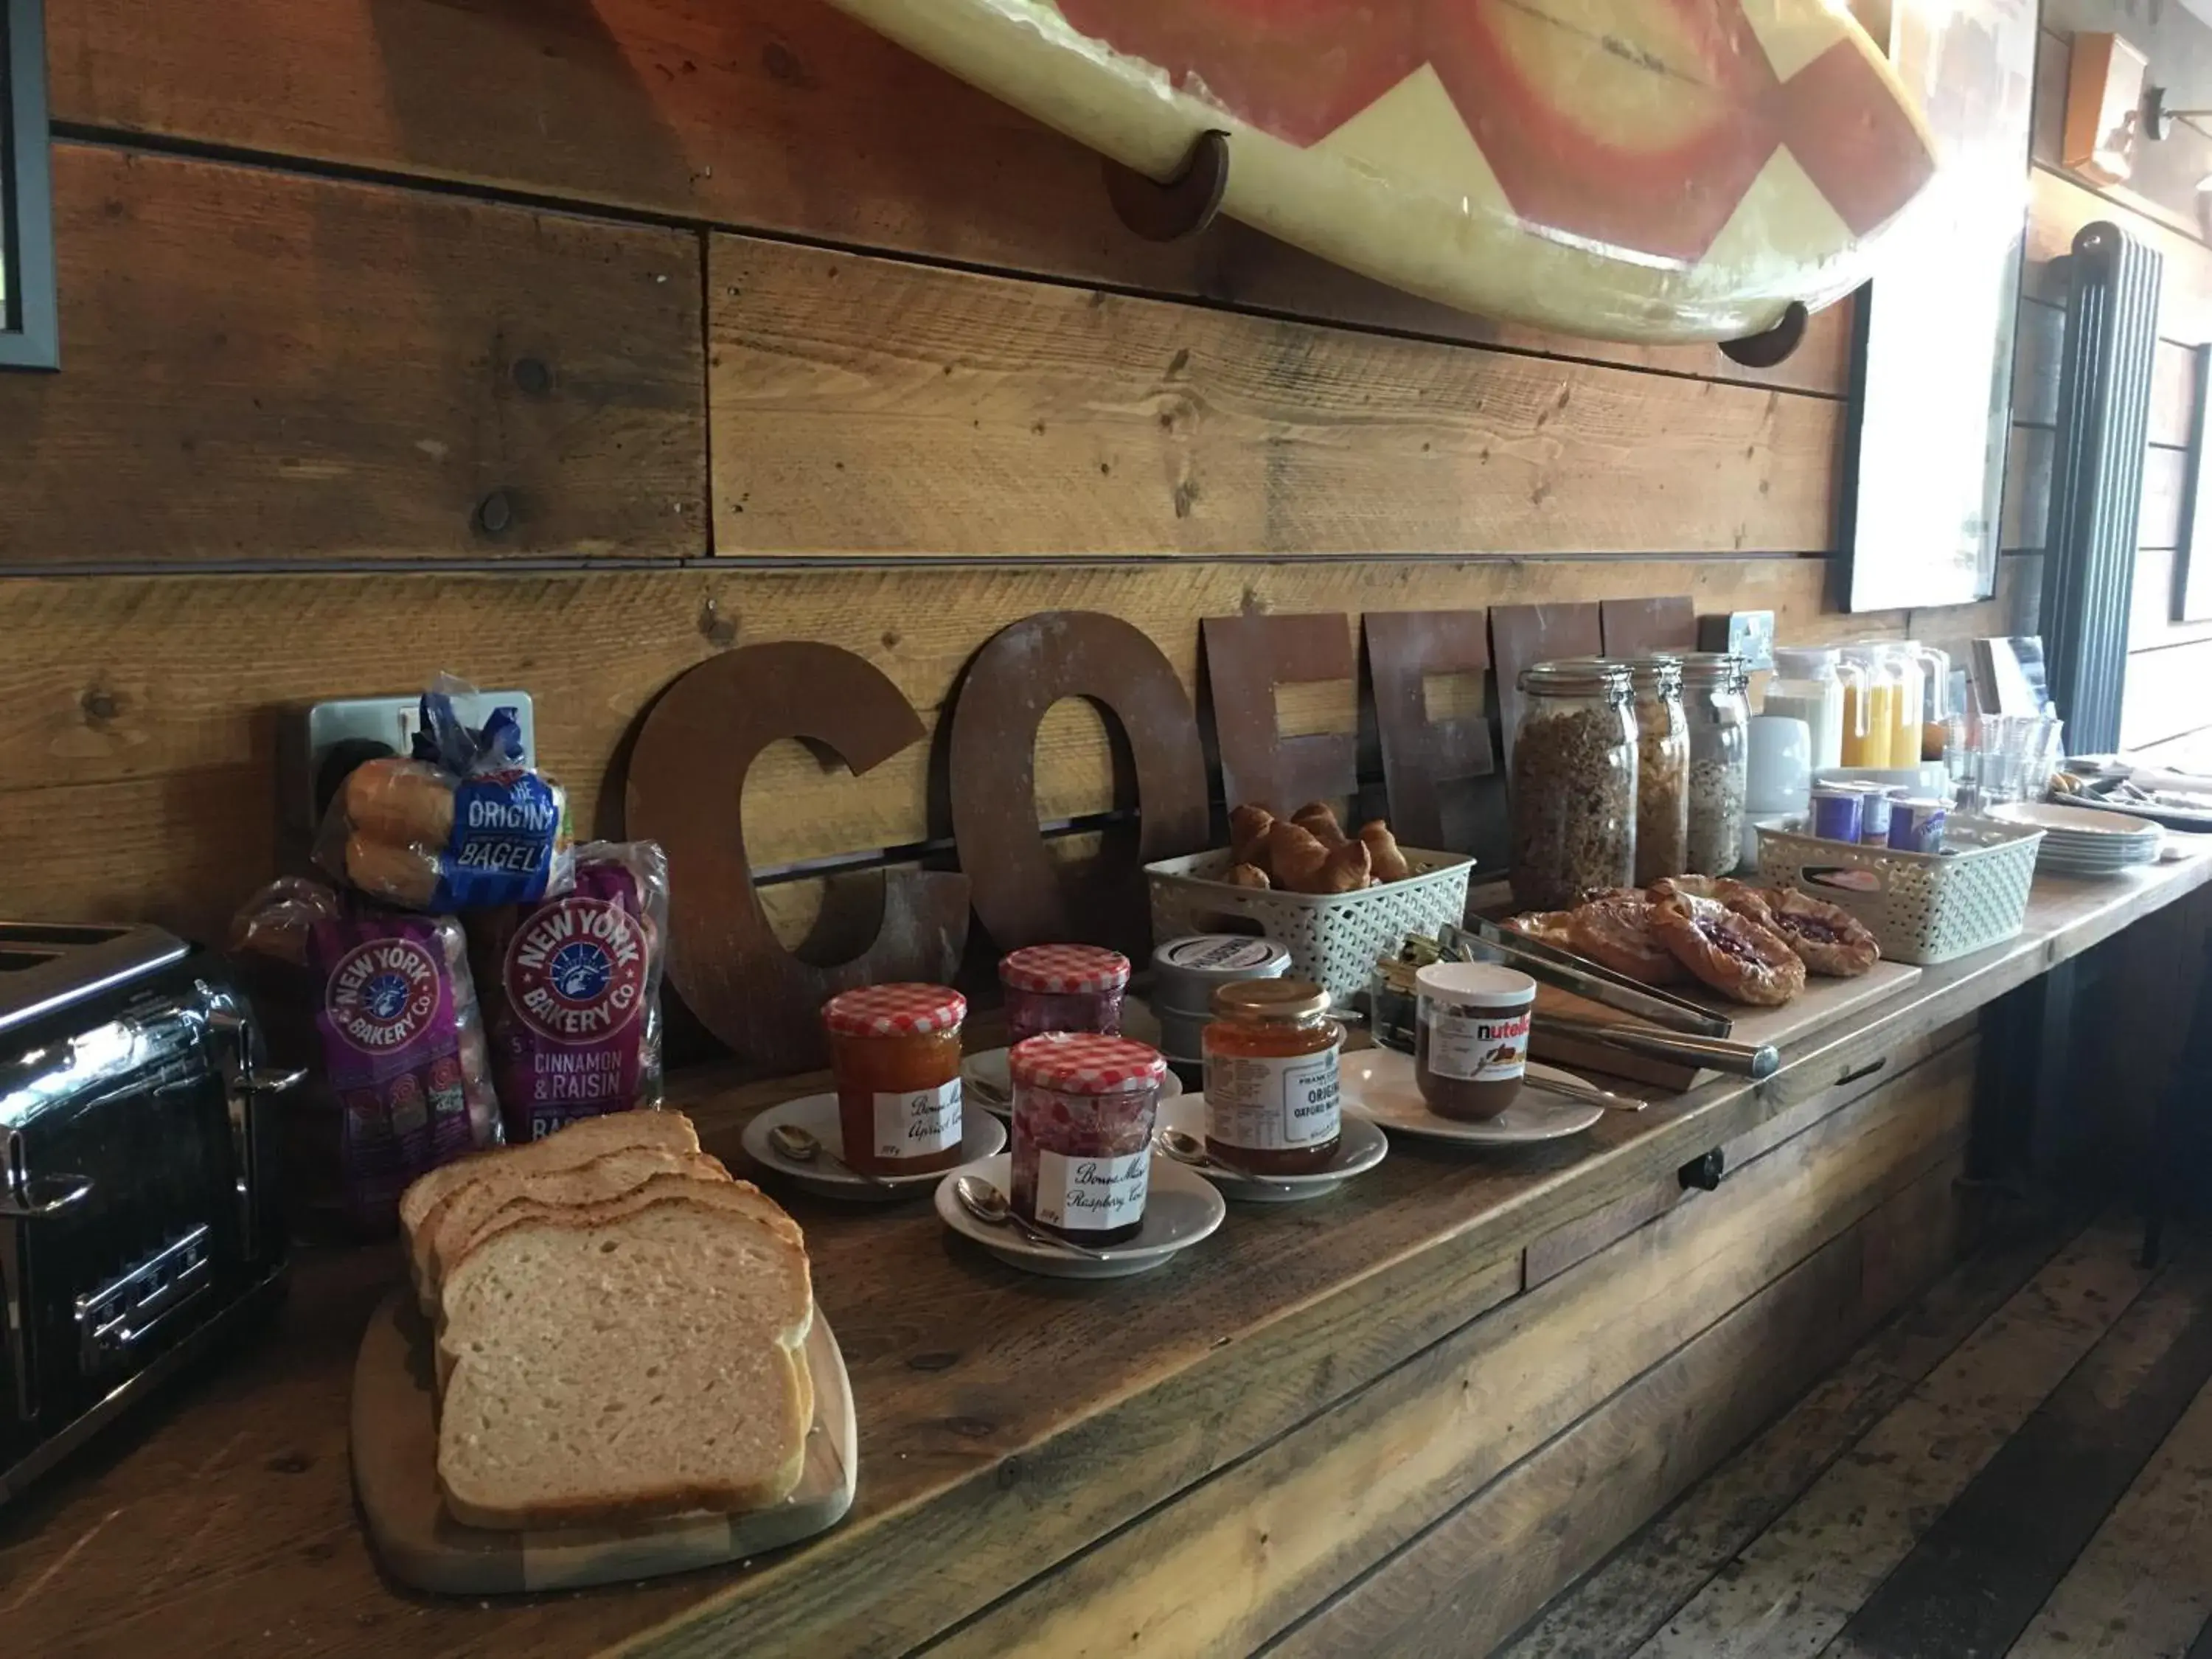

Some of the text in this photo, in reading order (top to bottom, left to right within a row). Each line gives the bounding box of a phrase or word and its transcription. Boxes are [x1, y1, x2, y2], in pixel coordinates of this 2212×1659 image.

[517, 907, 640, 970] NEW YORK
[335, 946, 432, 1005] NEW YORK
[522, 987, 613, 1034] BAKERY
[348, 1015, 417, 1046] BAKERY
[534, 1049, 622, 1074] CINNAMON
[533, 1071, 620, 1100] & RAISIN
